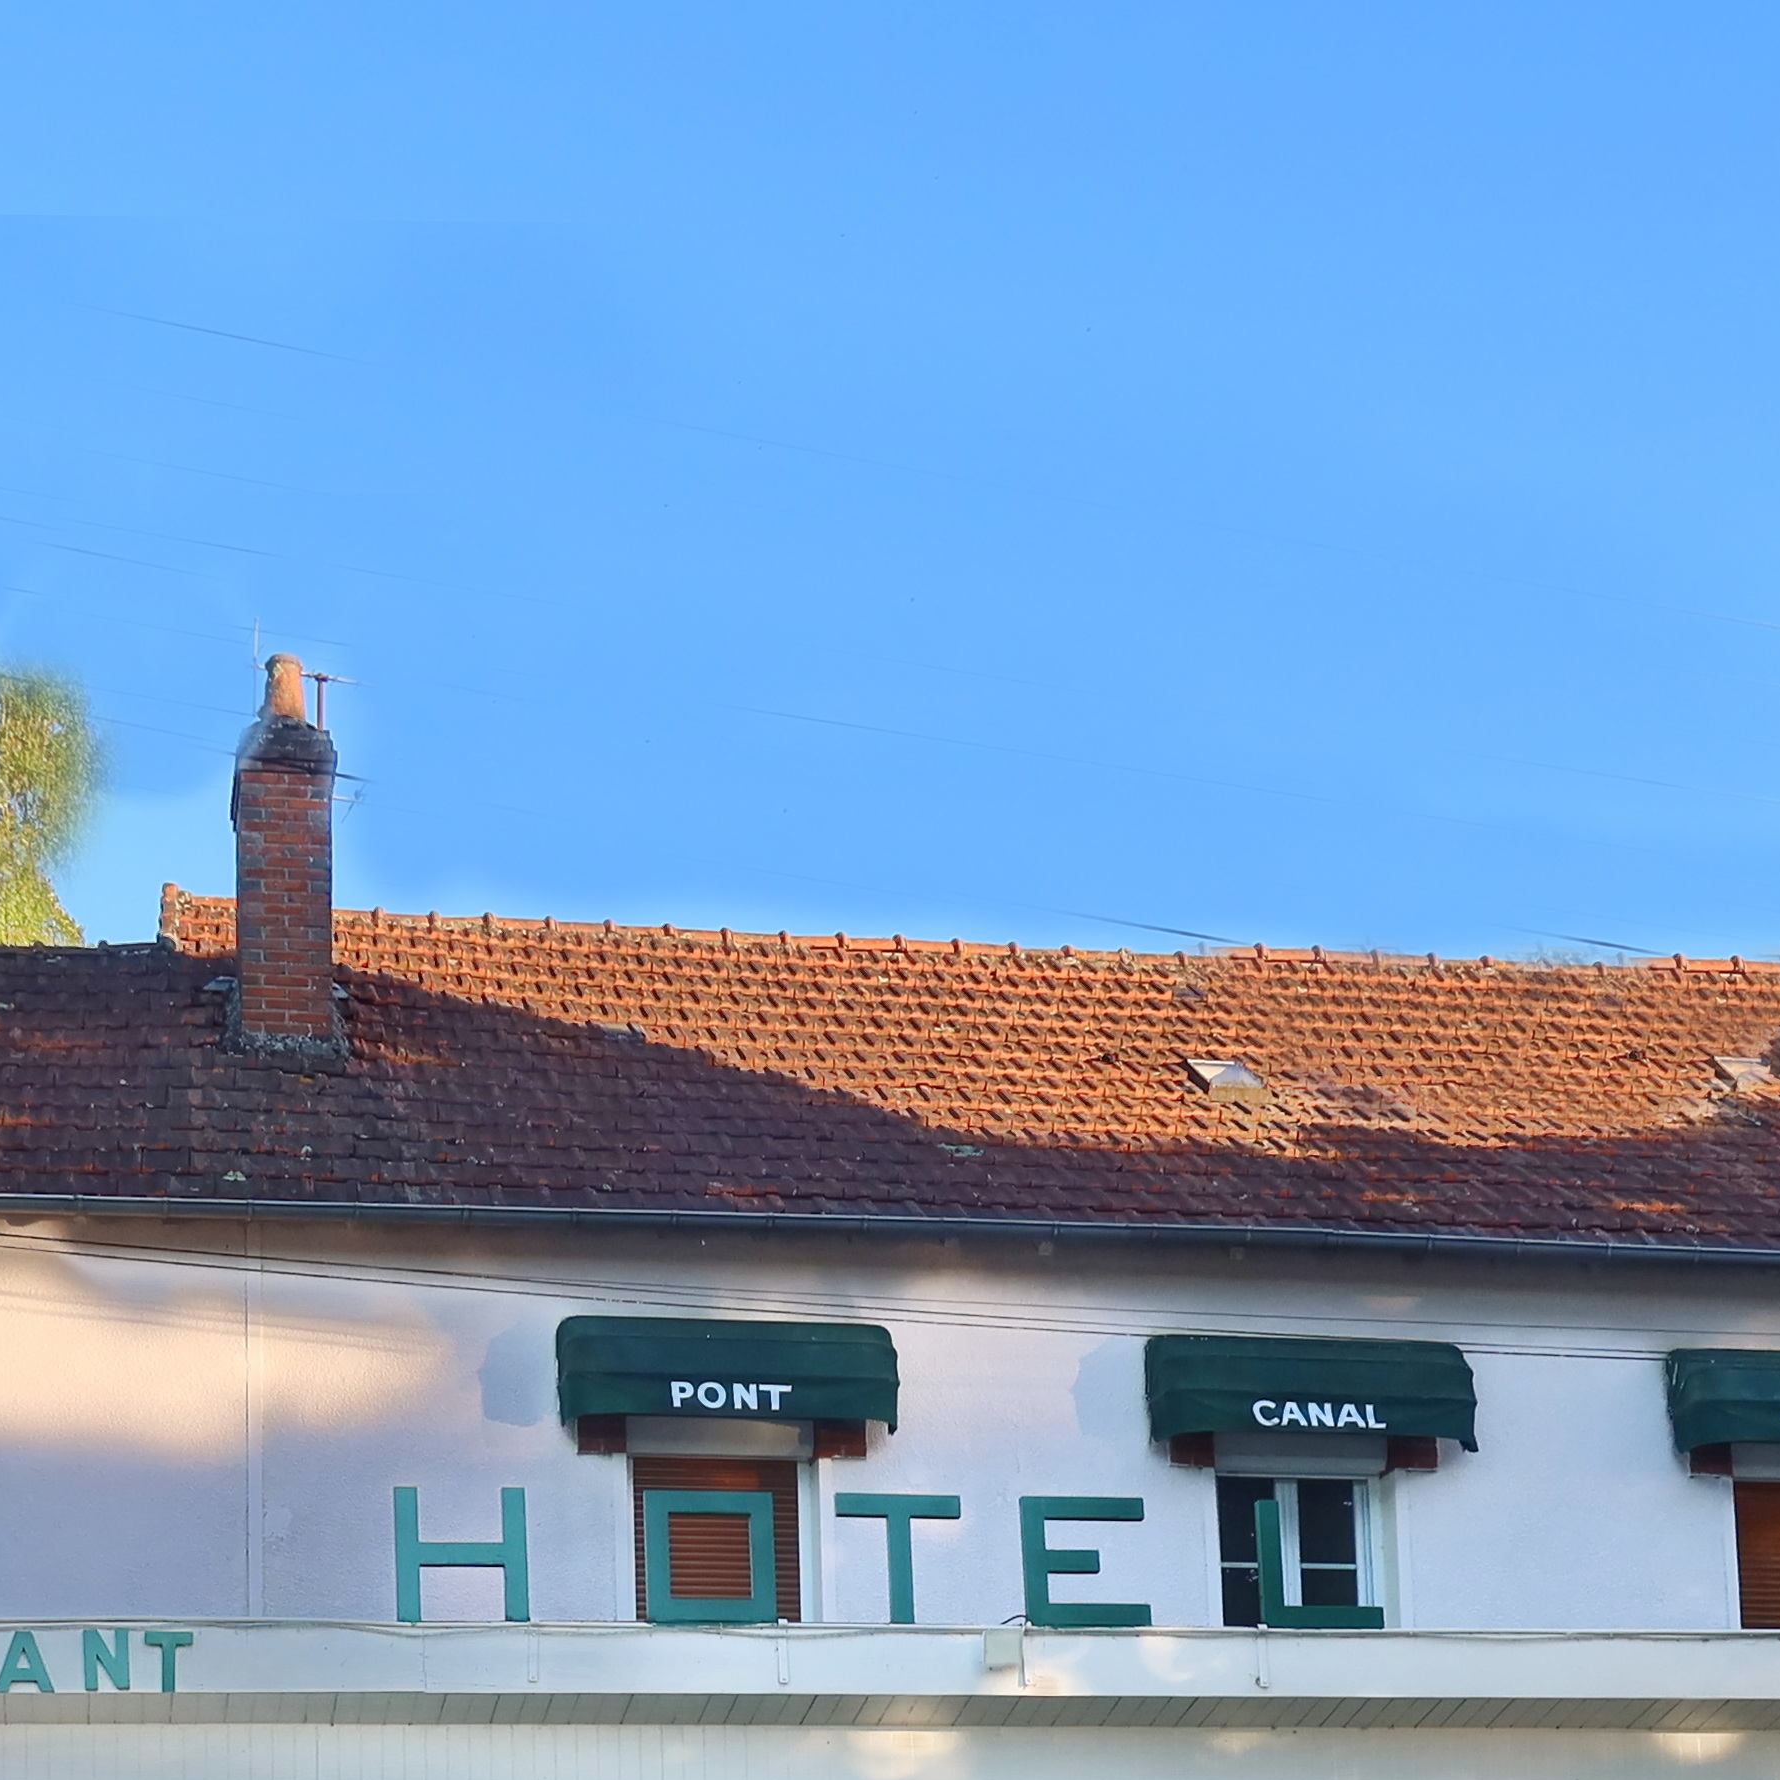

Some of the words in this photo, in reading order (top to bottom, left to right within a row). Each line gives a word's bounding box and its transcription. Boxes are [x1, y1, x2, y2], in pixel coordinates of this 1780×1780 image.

[669, 1380, 793, 1412] PONT
[1251, 1398, 1388, 1432] CANAL
[393, 1486, 1385, 1631] HOTEL
